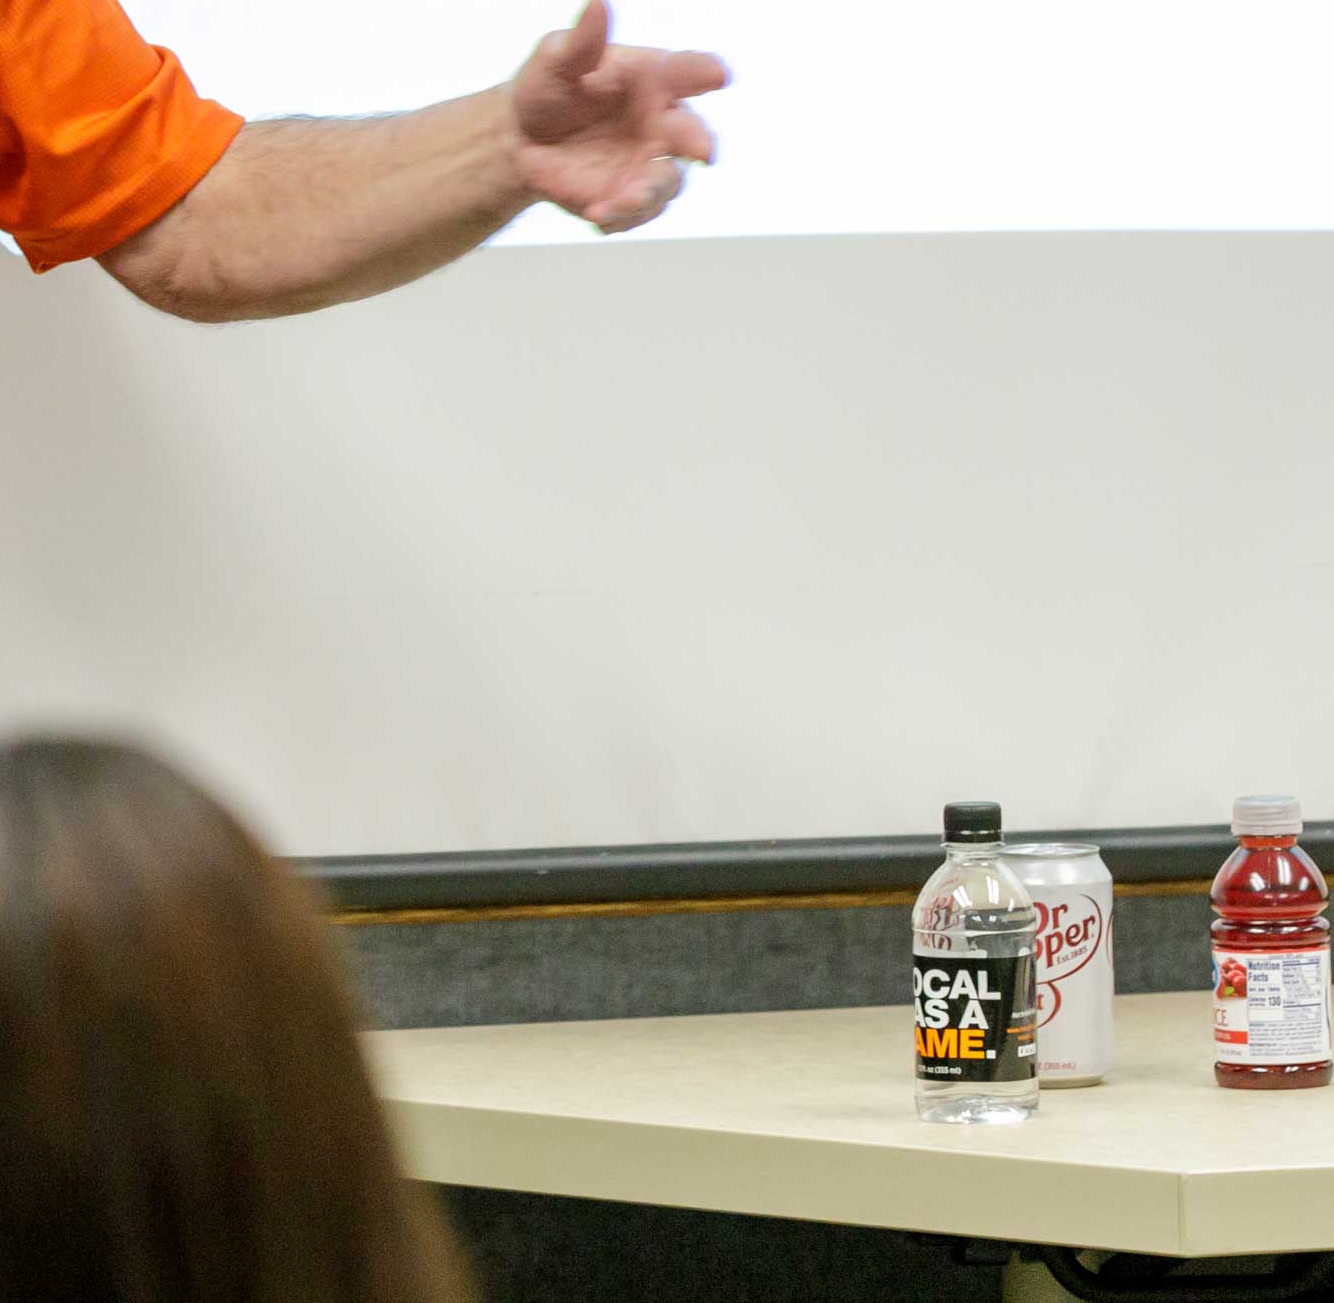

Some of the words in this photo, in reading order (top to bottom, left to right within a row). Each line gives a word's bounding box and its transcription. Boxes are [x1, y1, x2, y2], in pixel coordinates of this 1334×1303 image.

[913, 967, 1001, 1000] OCAL
[915, 997, 949, 1029] AS
[958, 1000, 989, 1029] A
[915, 1026, 996, 1059] AME.
